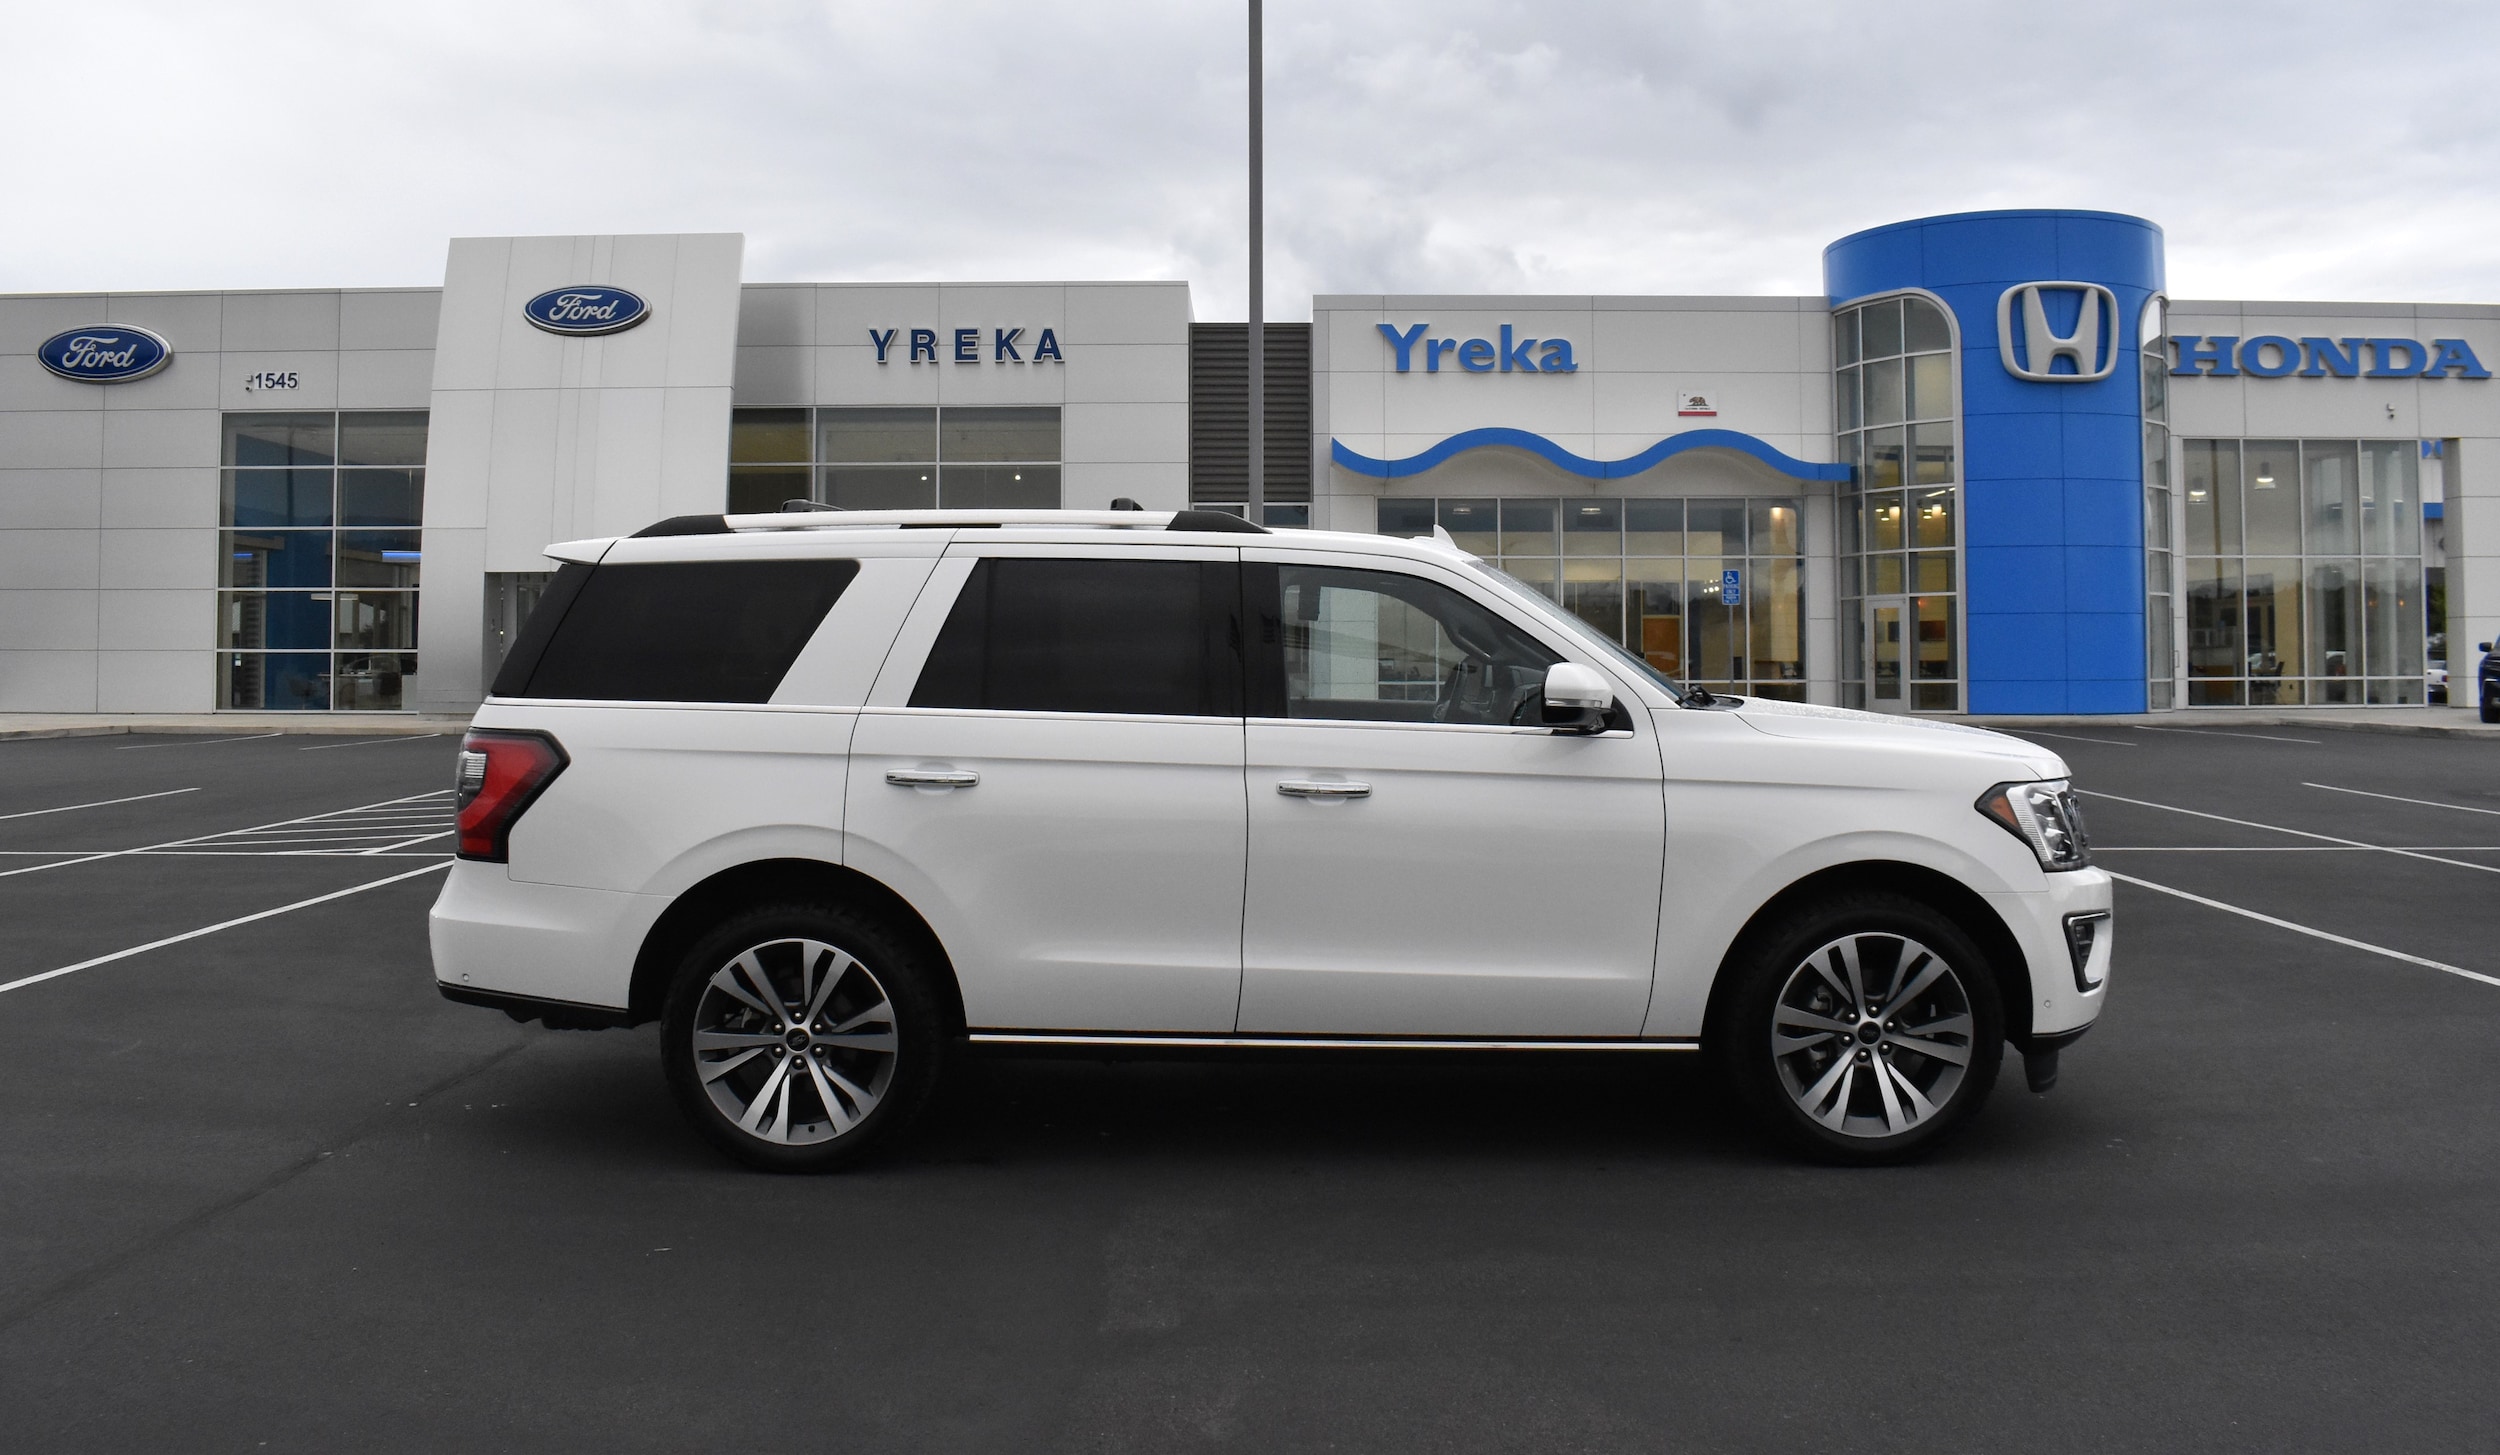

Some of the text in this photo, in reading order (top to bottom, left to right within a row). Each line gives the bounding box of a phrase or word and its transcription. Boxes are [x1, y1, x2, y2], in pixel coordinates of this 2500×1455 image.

[548, 293, 619, 321] Ford
[62, 336, 137, 368] Ford
[868, 328, 1065, 363] YREKA
[1375, 323, 1579, 373] Yreka
[2169, 335, 2492, 379] HONDA
[255, 372, 298, 389] 1545
